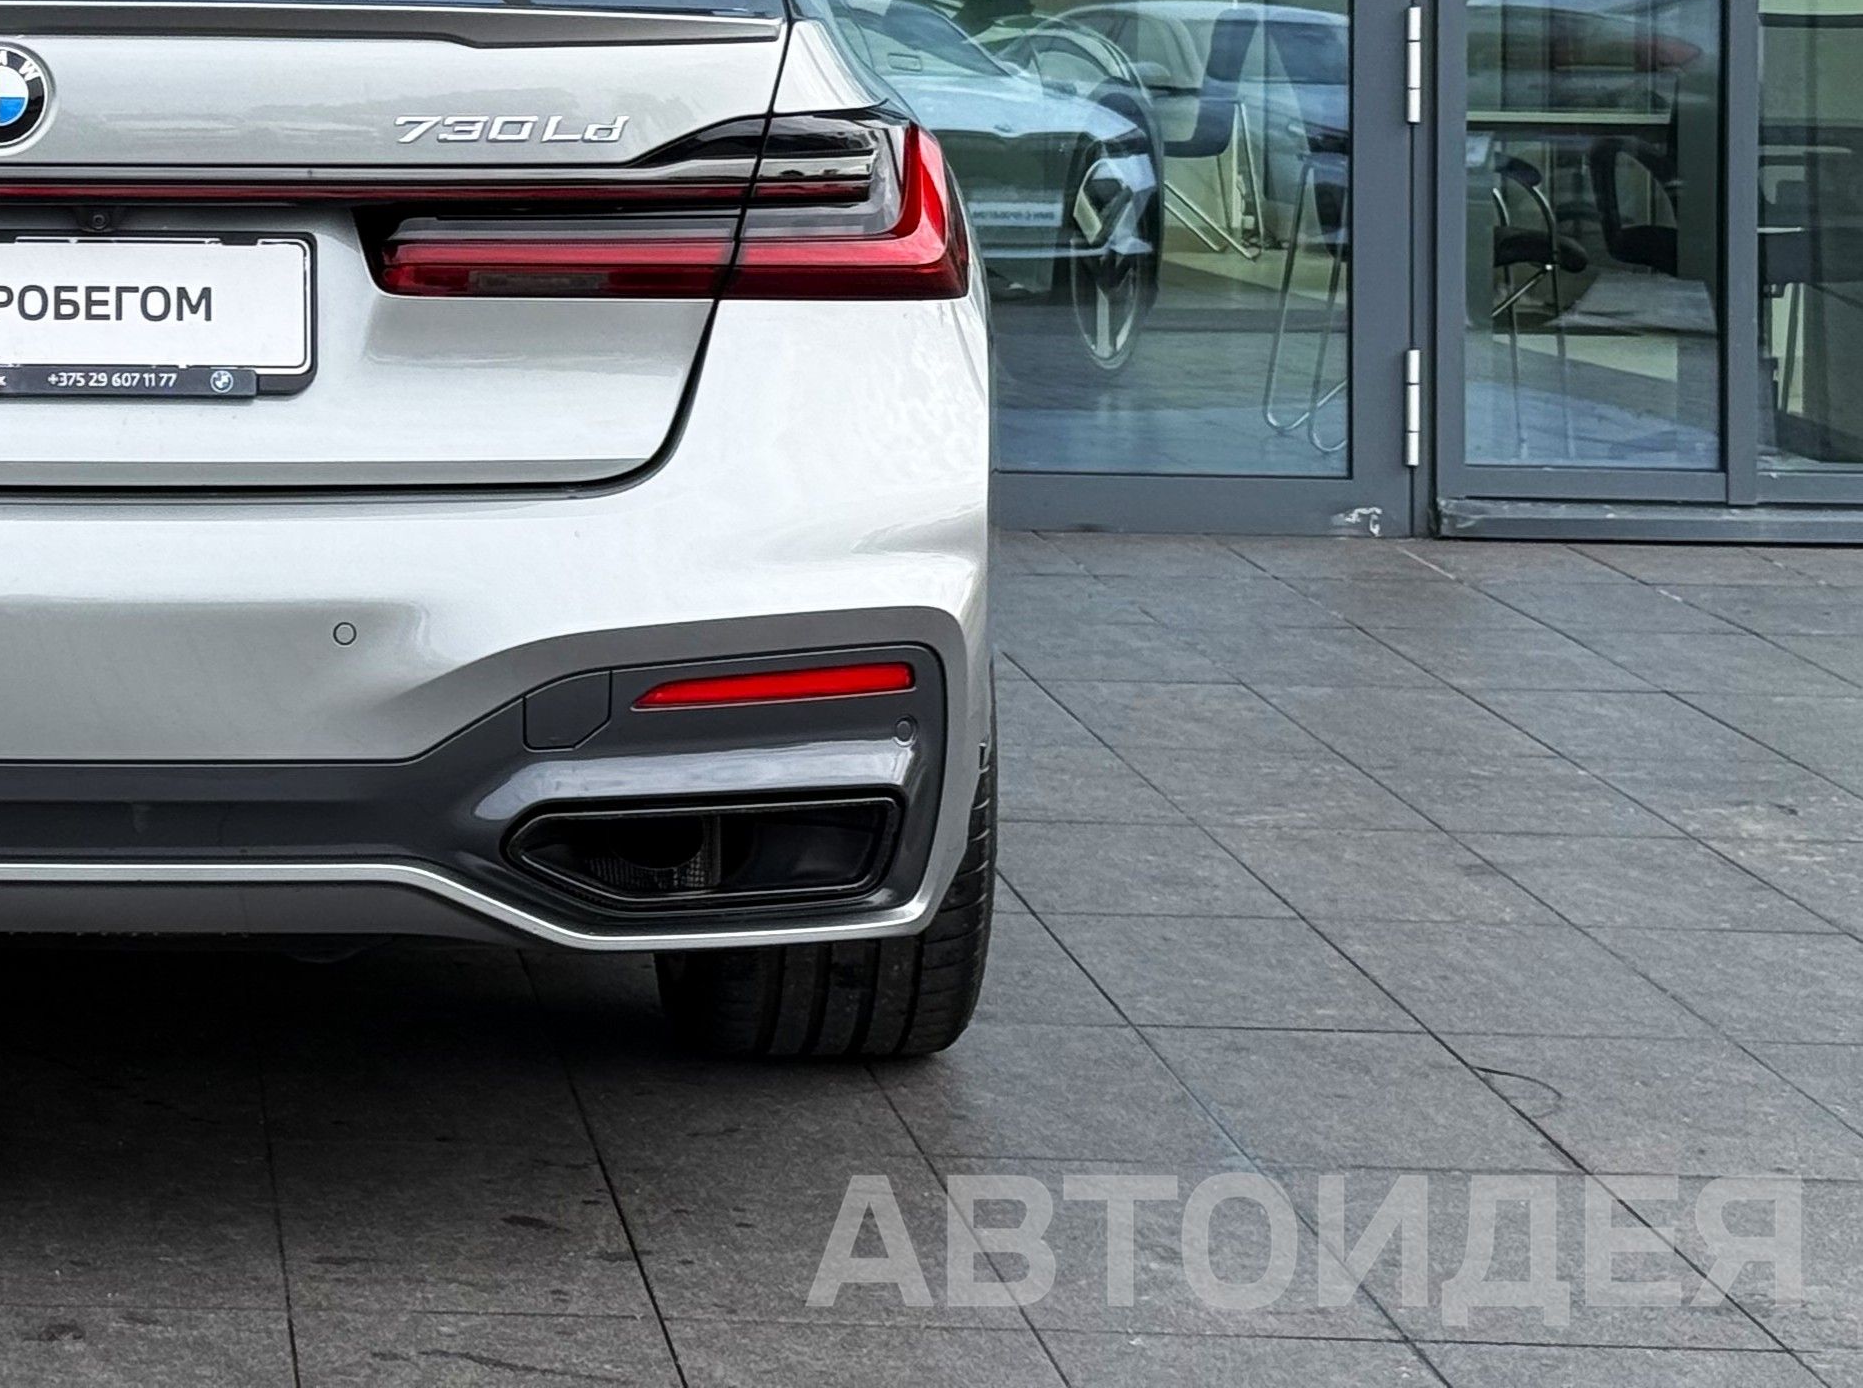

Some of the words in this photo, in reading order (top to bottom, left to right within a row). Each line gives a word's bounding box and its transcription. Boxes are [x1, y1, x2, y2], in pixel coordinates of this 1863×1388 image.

[394, 114, 631, 144] 730Ld
[47, 372, 87, 388] +375
[88, 372, 109, 388] 29
[112, 372, 140, 387] 607
[142, 372, 156, 388] 11
[158, 372, 178, 388] 77
